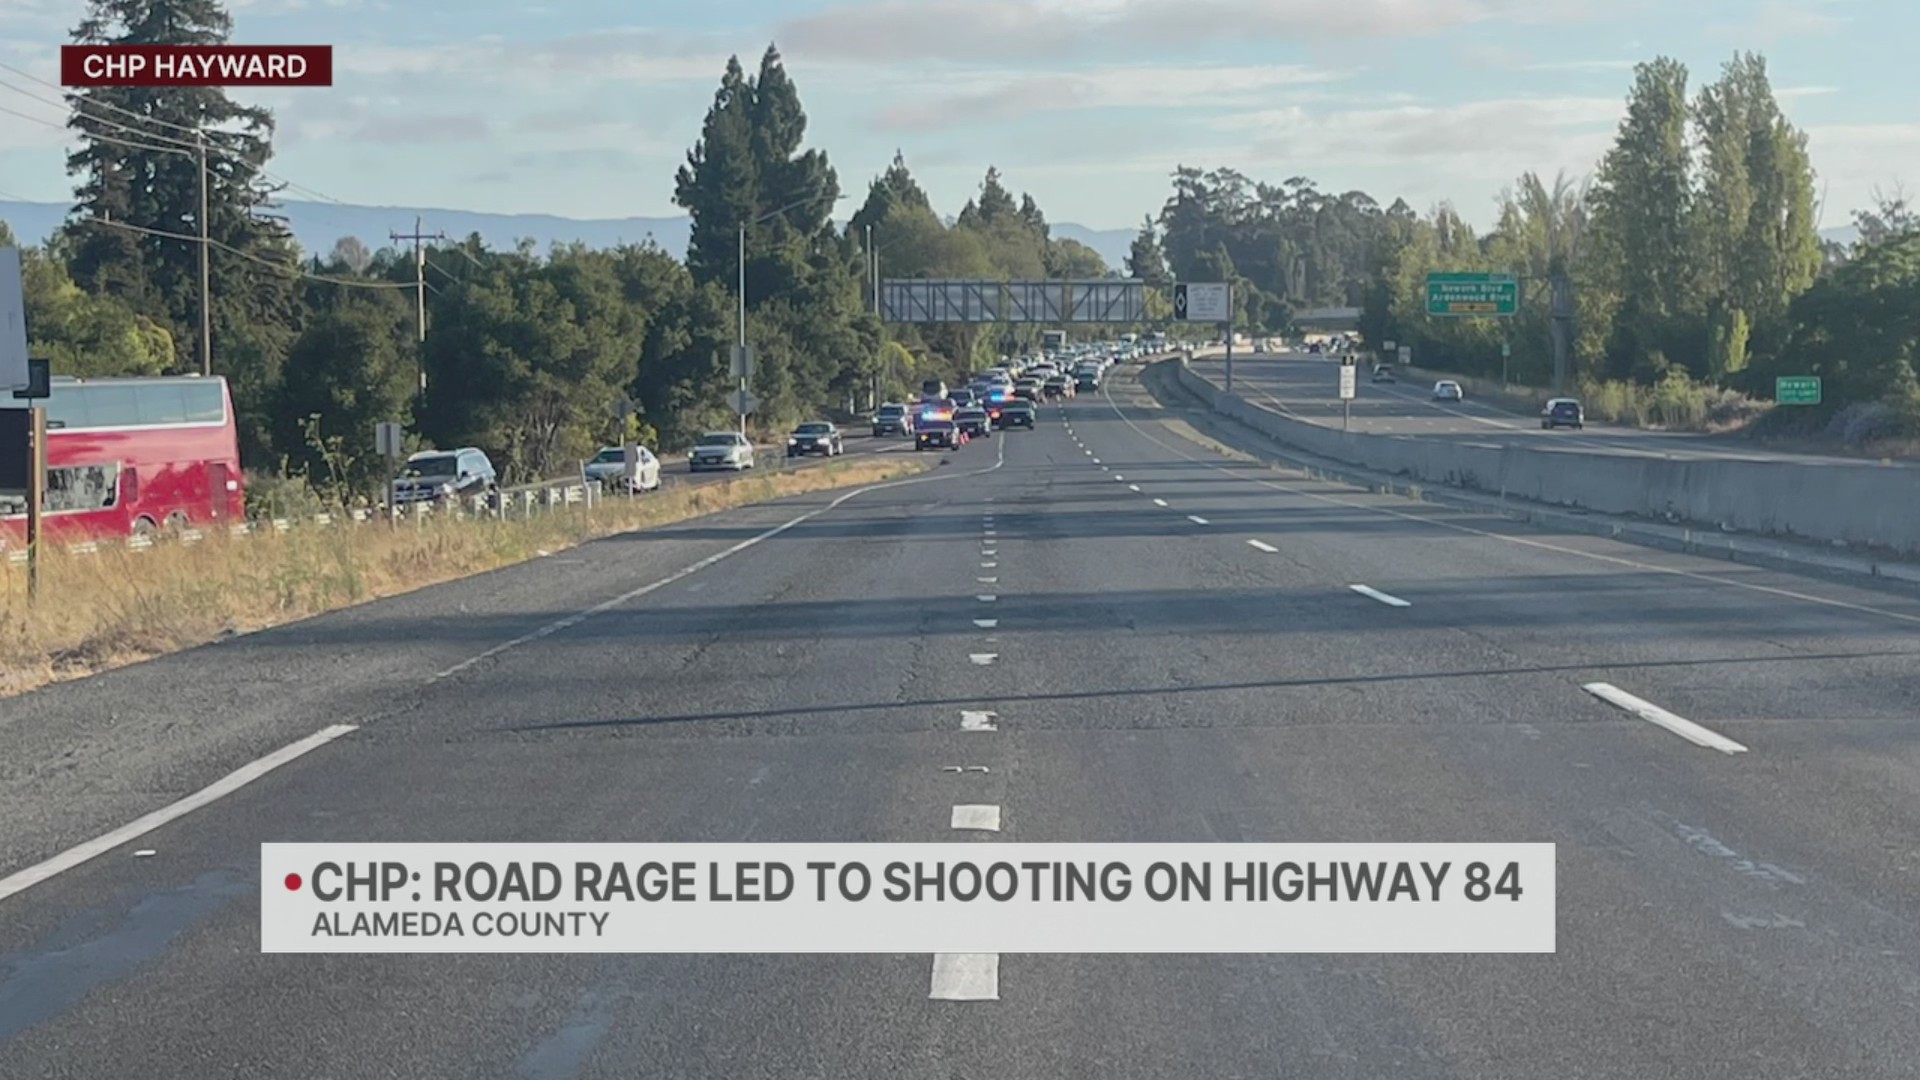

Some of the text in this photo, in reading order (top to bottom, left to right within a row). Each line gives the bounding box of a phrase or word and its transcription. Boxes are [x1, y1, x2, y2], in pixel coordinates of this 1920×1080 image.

[1441, 284, 1503, 293] Newark Blvd
[1432, 293, 1512, 302] Ardenwood Blvd
[1780, 381, 1817, 389] Newark
